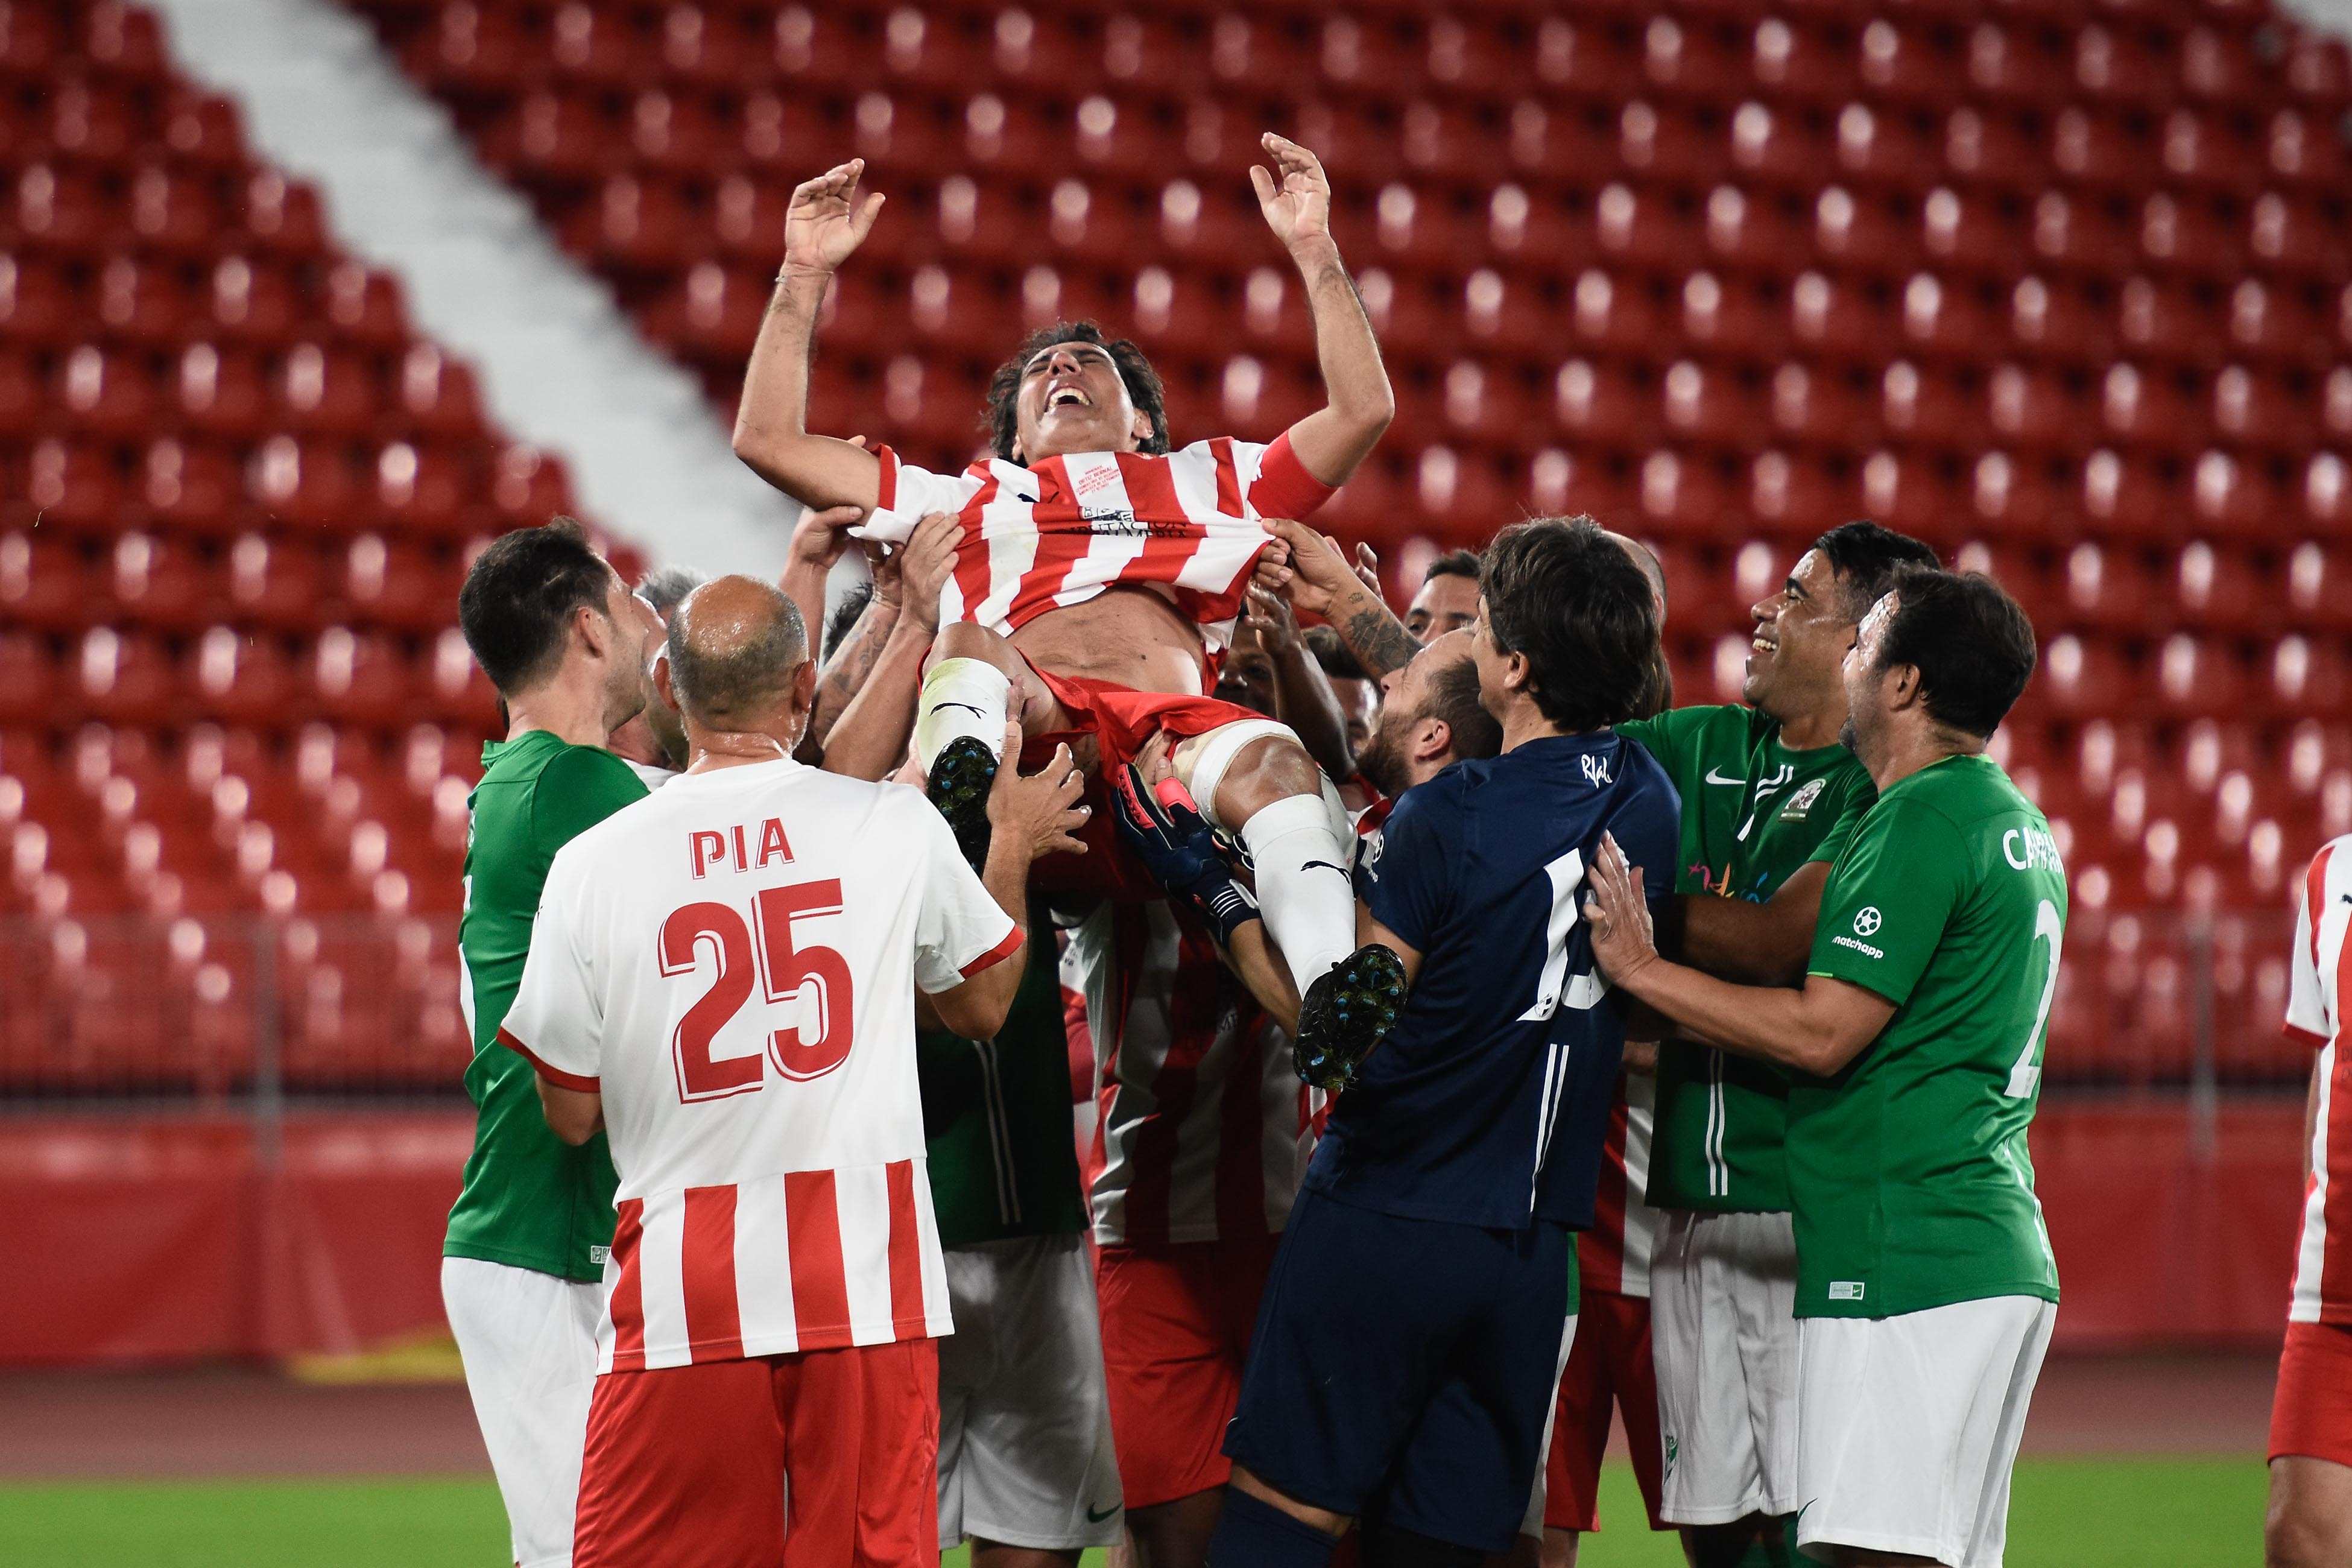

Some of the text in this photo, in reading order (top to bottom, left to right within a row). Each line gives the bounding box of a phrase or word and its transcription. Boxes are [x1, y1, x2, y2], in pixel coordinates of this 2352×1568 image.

[689, 817, 794, 880] PIA
[1832, 935, 1884, 959] matchapp
[658, 878, 854, 1104] 25
